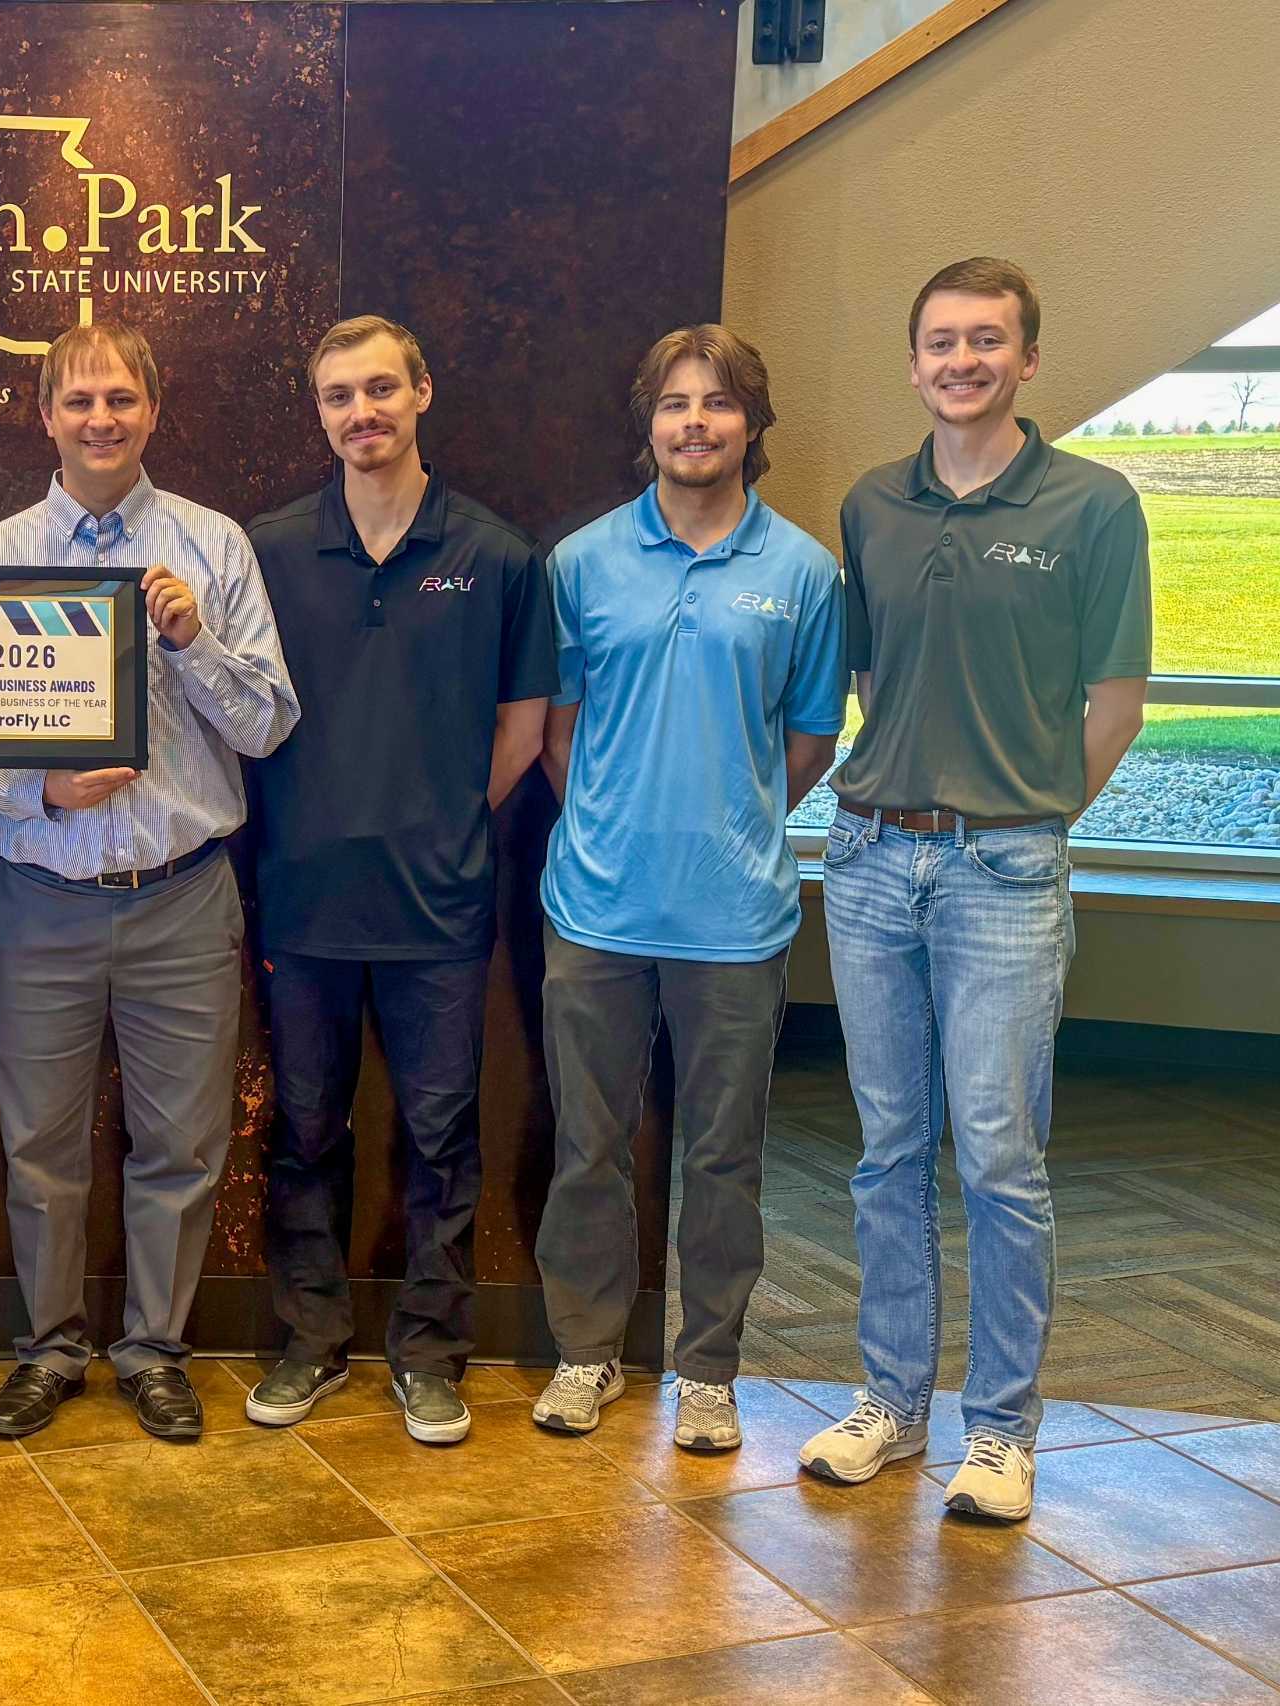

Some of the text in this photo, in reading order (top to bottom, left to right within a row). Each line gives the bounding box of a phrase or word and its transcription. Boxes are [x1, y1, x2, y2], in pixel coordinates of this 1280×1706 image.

[77, 172, 266, 254] Park
[11, 269, 92, 293] STATE
[103, 270, 267, 293] UNIVERSITY
[50, 680, 96, 693] AWARDS
[0, 698, 45, 708] BUSINESS
[47, 698, 61, 708] OF
[64, 699, 81, 709] THE
[84, 699, 107, 709] YEAR
[43, 715, 71, 728] LLC
